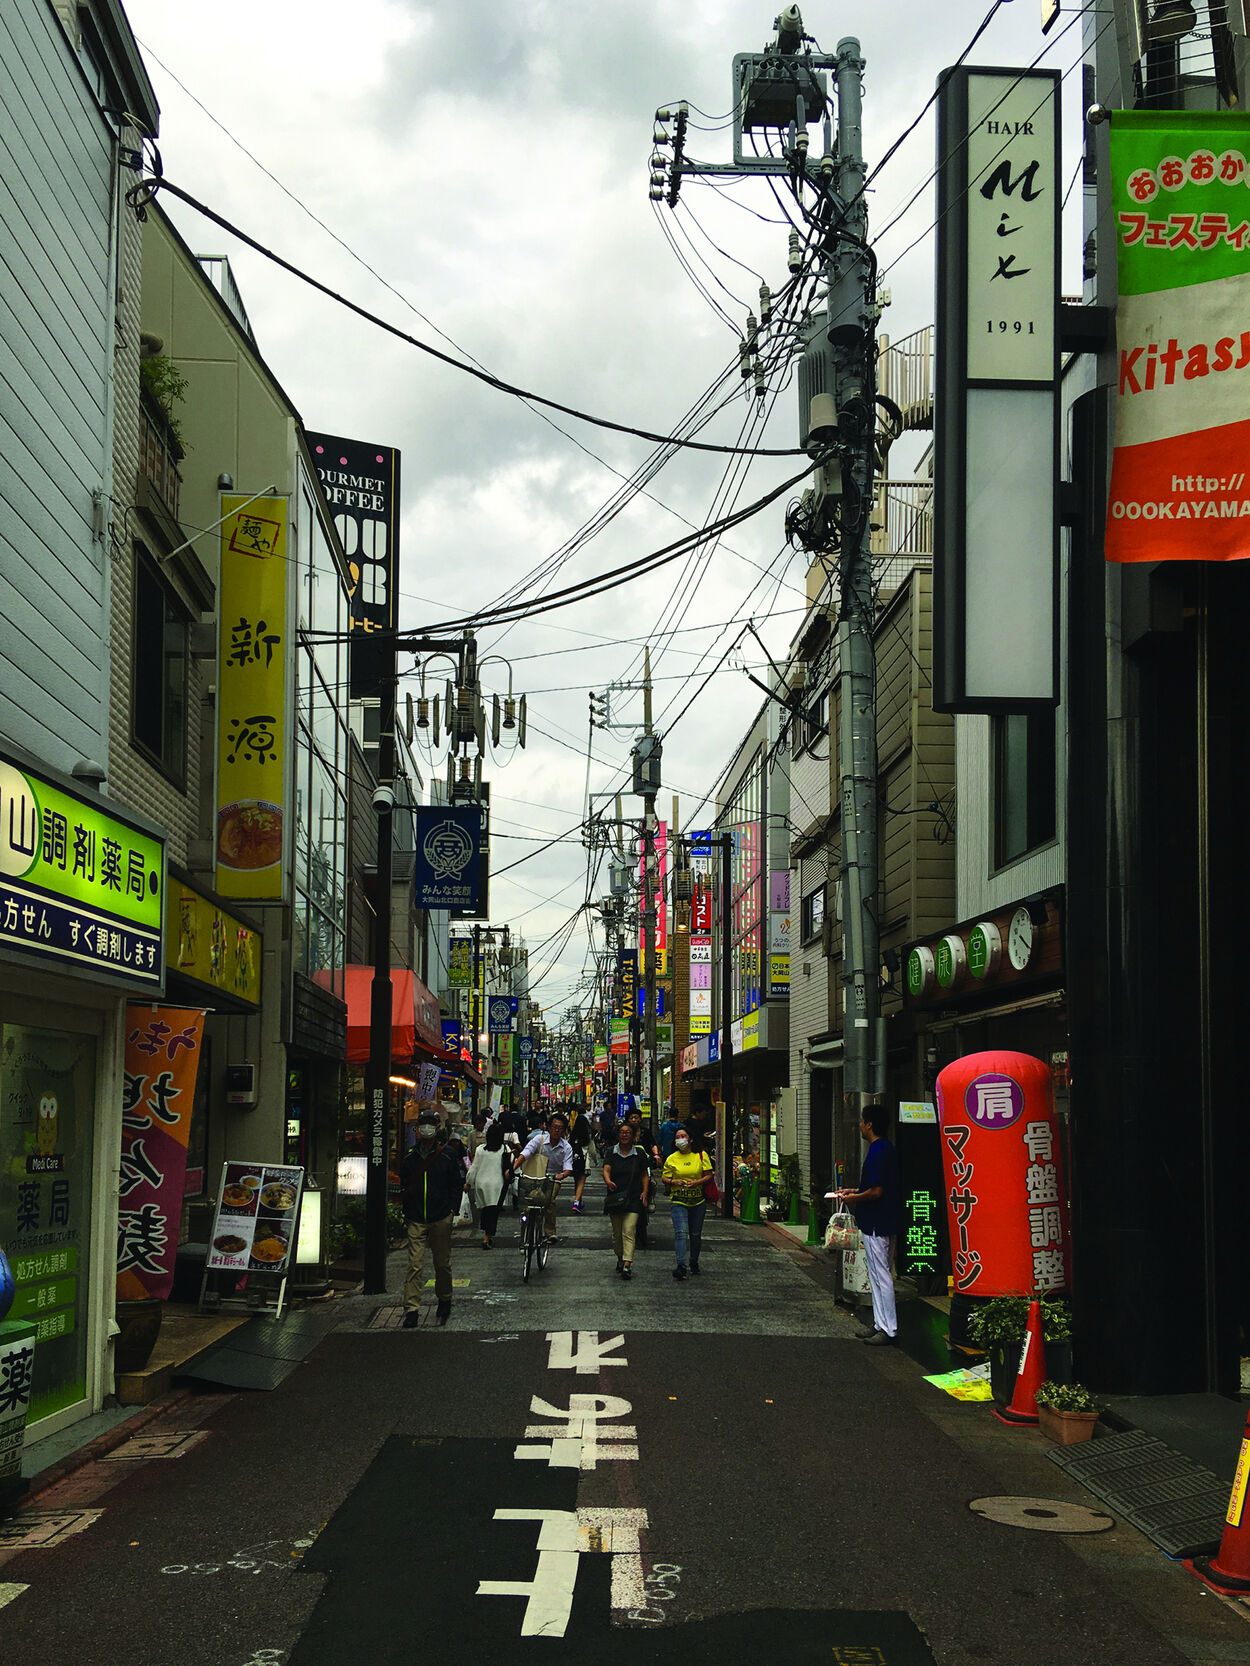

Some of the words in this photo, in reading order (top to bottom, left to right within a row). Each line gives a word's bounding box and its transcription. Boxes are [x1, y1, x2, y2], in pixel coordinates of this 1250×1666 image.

[987, 120, 1035, 136] HAIR
[1130, 154, 1244, 200] おおおか
[1120, 214, 1250, 247] フェスティ
[986, 319, 1036, 335] 1991
[1171, 473, 1245, 493] http://
[226, 617, 281, 765] 新源
[0, 786, 145, 902] 山調剤薬局
[422, 885, 471, 897] みんな笑顔
[0, 898, 52, 939] 方せん
[69, 919, 156, 968] すぐ調剤します
[445, 1033, 458, 1055] KA
[975, 1081, 1015, 1120] 肩
[372, 1089, 384, 1166] 防犯カメラ稼働中
[32, 1158, 46, 1170] Medi
[46, 1157, 60, 1169] Care
[17, 1179, 70, 1233] 薬局
[943, 1125, 982, 1290] マッサージ
[1023, 1120, 1066, 1293] 骨盤調整
[16, 1252, 68, 1281] 処方せん調剤
